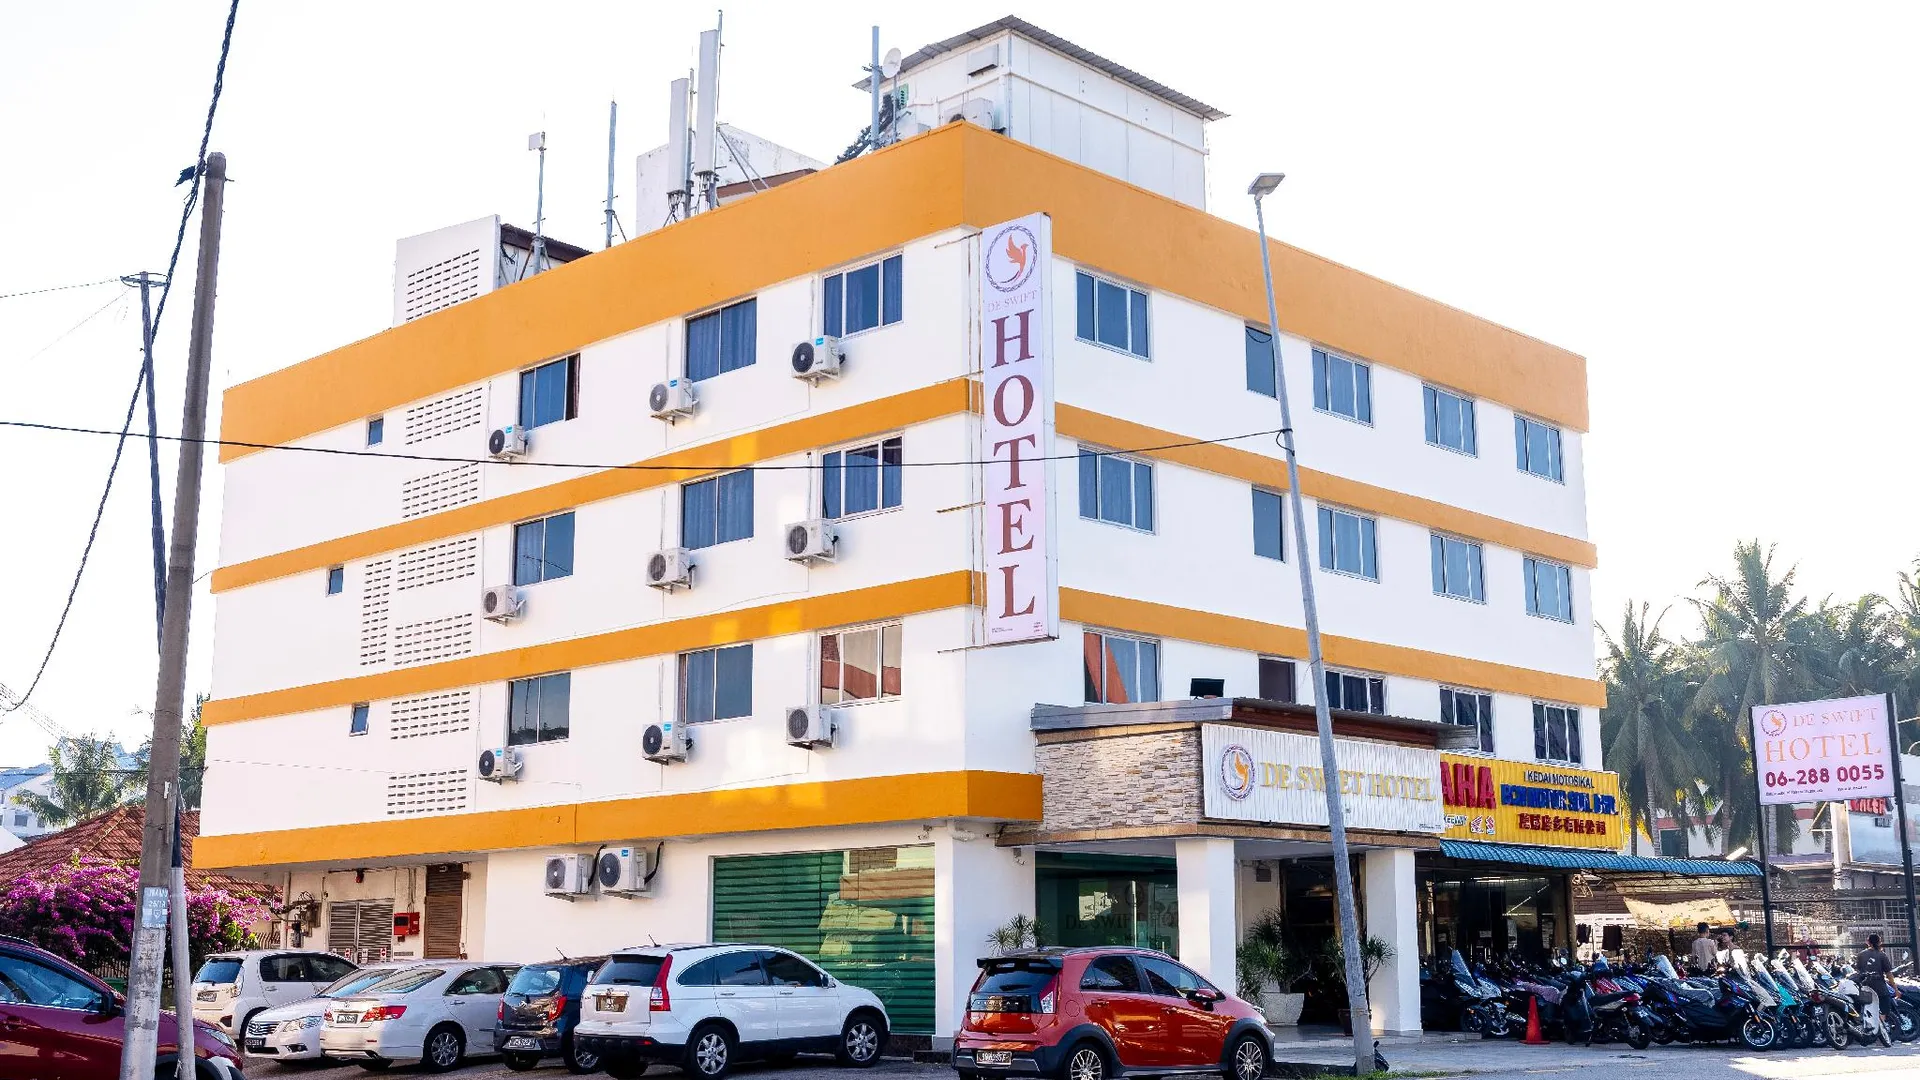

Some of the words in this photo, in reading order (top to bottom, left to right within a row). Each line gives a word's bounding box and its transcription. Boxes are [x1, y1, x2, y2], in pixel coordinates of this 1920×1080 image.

[988, 301, 1003, 312] DE
[1005, 290, 1037, 307] SWIFT
[991, 309, 1035, 618] HOTEL
[1793, 714, 1815, 727] DE
[1821, 708, 1878, 724] SWIFT
[1764, 732, 1882, 765] HOTEL
[1259, 763, 1293, 787] DE
[1296, 766, 1366, 795] SWT
[1367, 774, 1437, 801] HOTEL
[1526, 770, 1550, 784] KEDAI
[1552, 775, 1595, 789] MOTOSIKAL
[1765, 767, 1830, 788] 06-288
[1837, 764, 1885, 782] 0055
